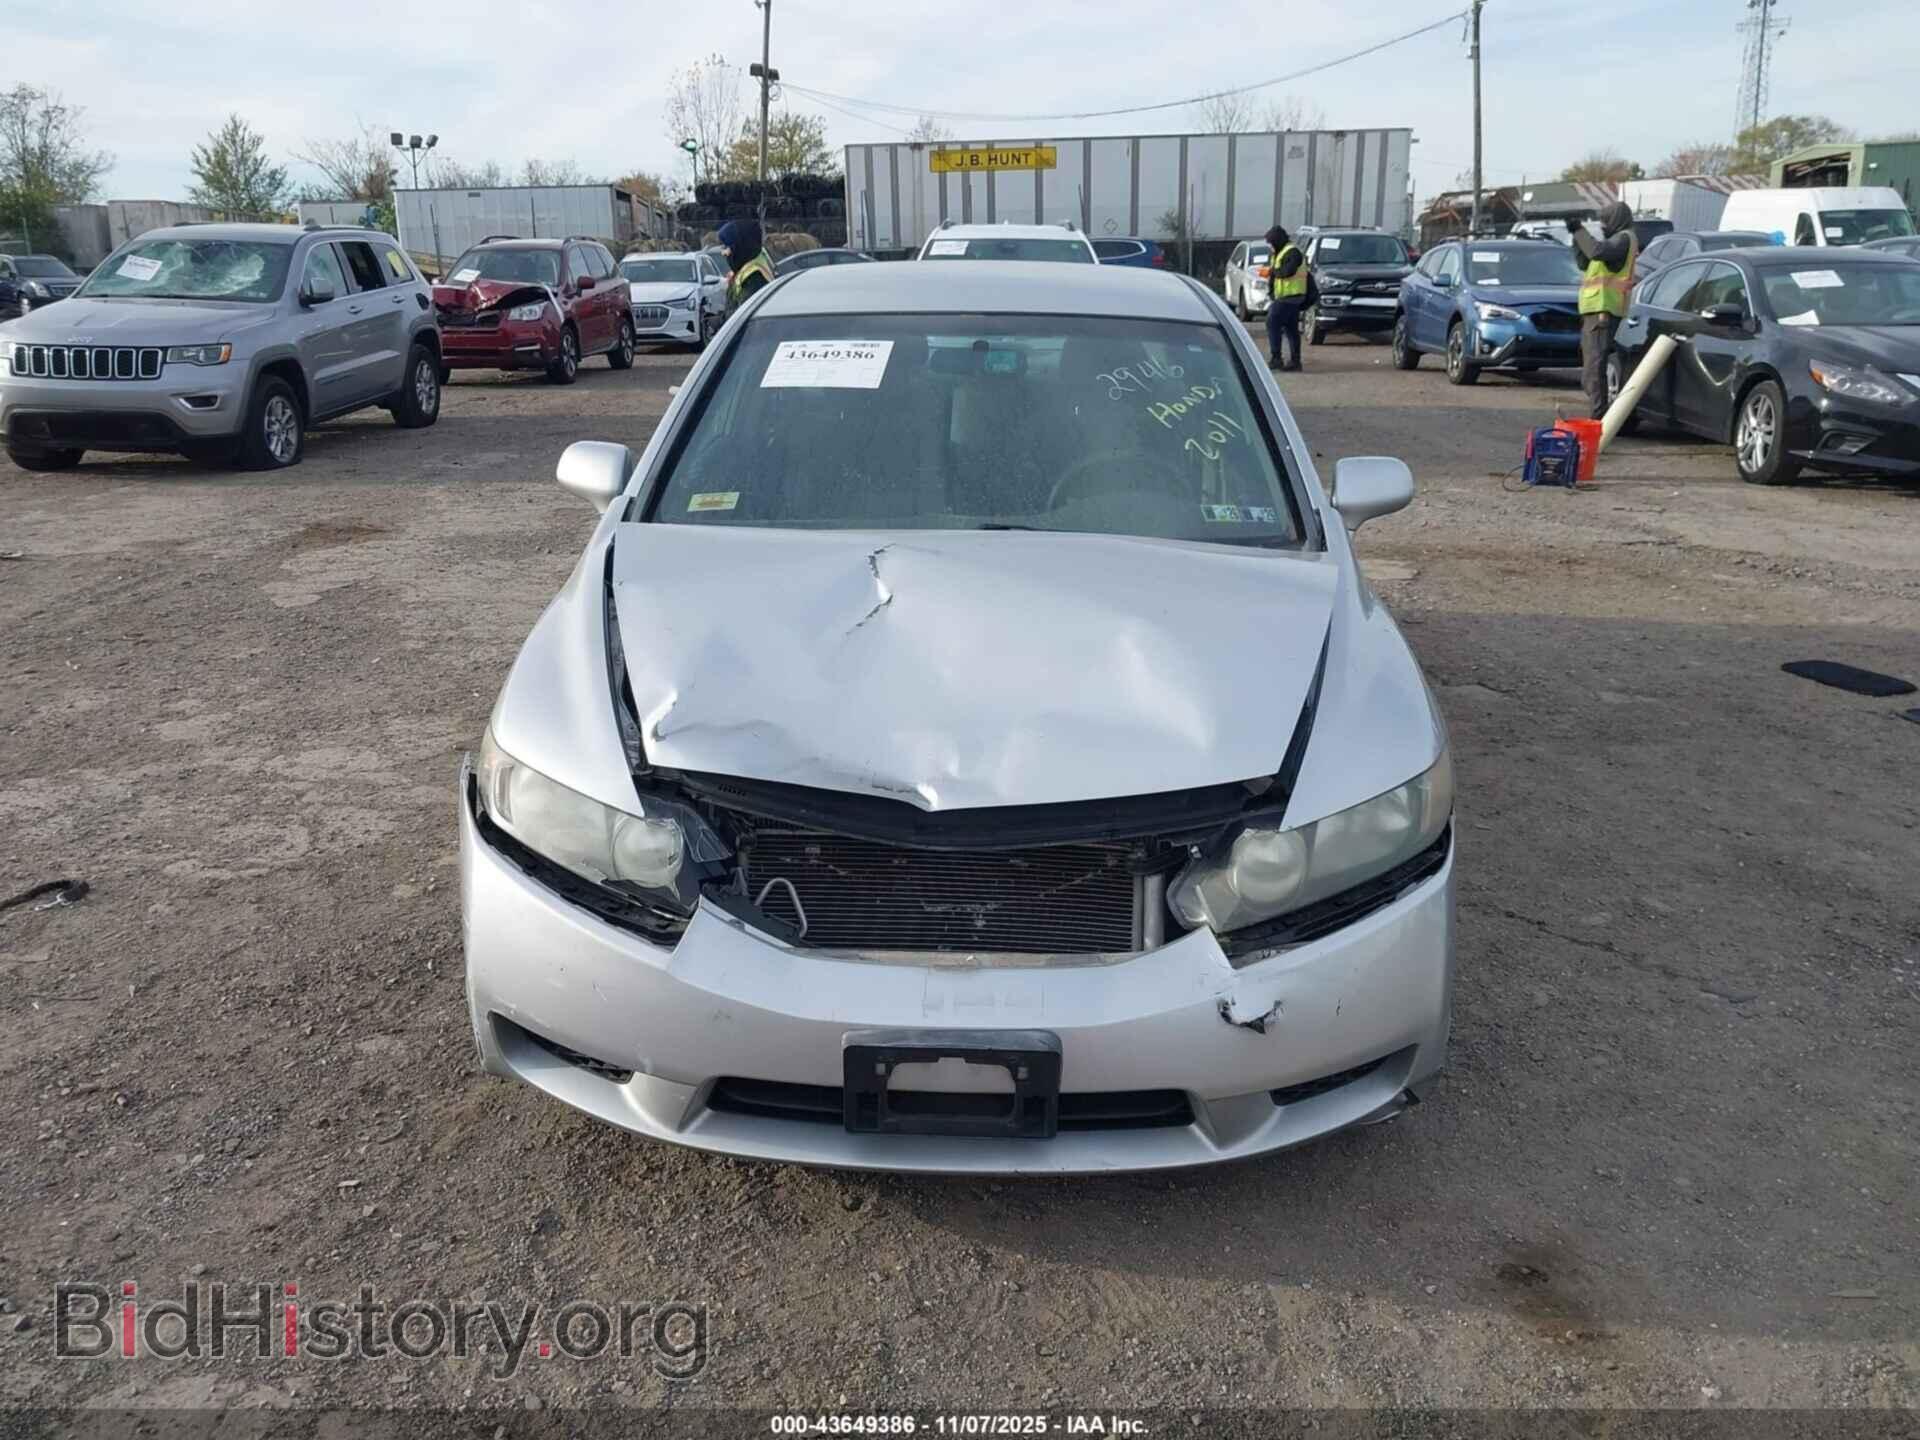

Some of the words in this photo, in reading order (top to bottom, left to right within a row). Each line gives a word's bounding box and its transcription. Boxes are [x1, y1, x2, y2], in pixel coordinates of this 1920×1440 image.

[955, 154, 984, 167] J.B.
[987, 152, 1032, 166] HUNT
[785, 350, 875, 360] 43649386
[1185, 411, 1244, 460] 2011
